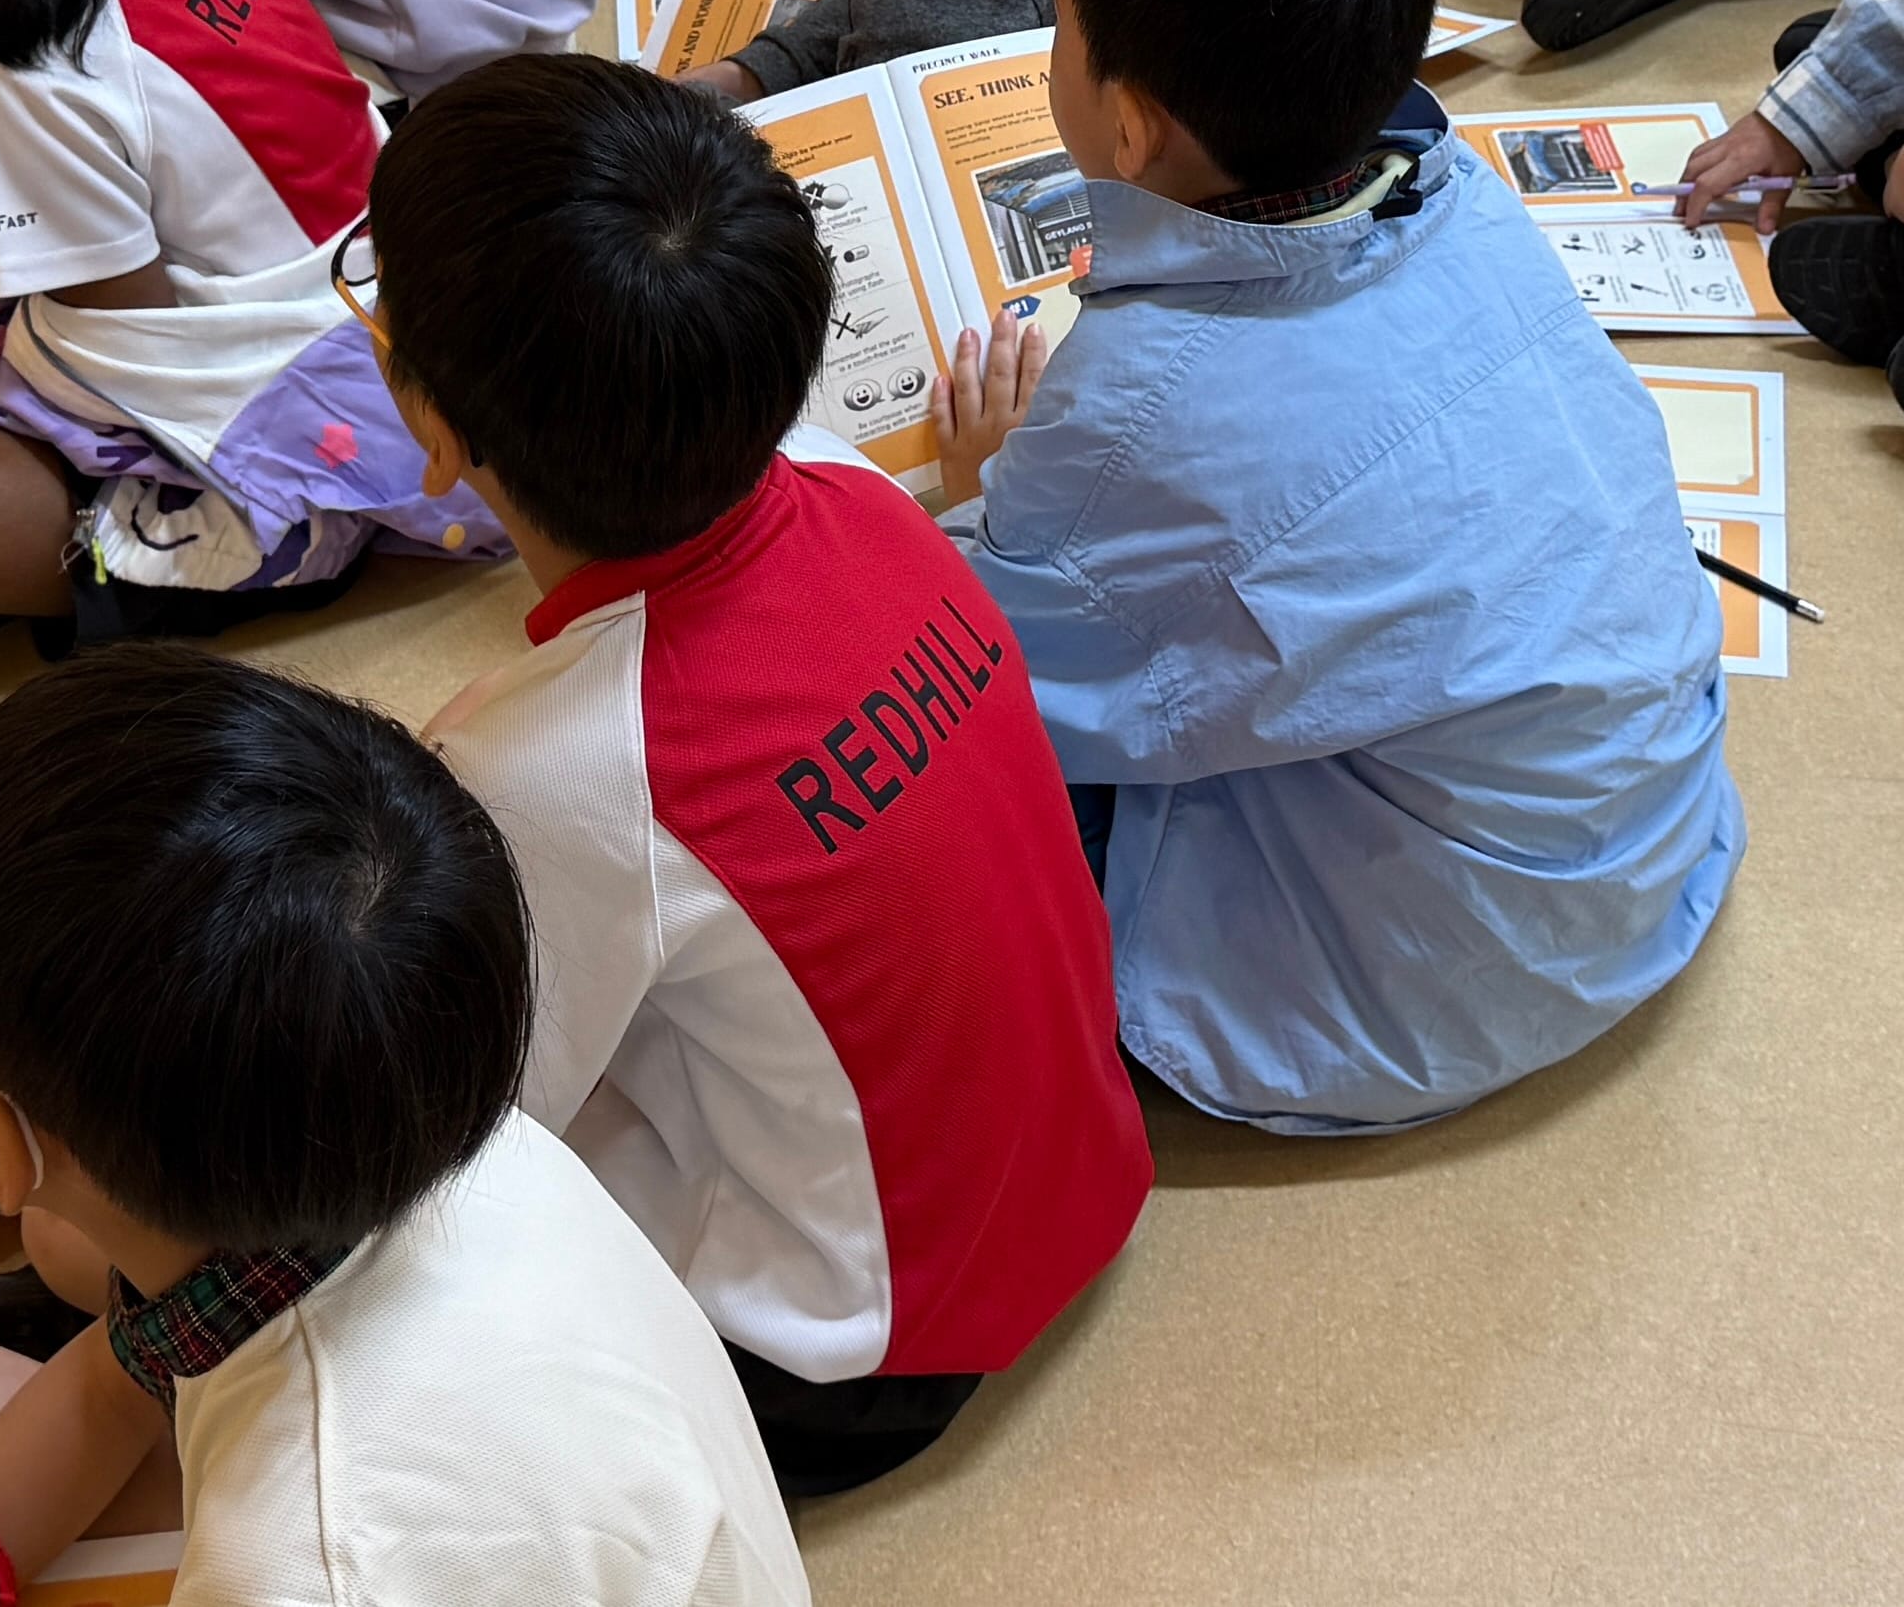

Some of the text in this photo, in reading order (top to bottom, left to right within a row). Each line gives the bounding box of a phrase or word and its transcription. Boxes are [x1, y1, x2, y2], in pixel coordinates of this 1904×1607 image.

[912, 47, 1002, 74] PRECINCT WALK
[933, 87, 975, 109] SEE.
[976, 74, 1035, 98] THINK
[1044, 223, 1086, 241] GEYLANG
[775, 596, 1003, 855] REDHILL
